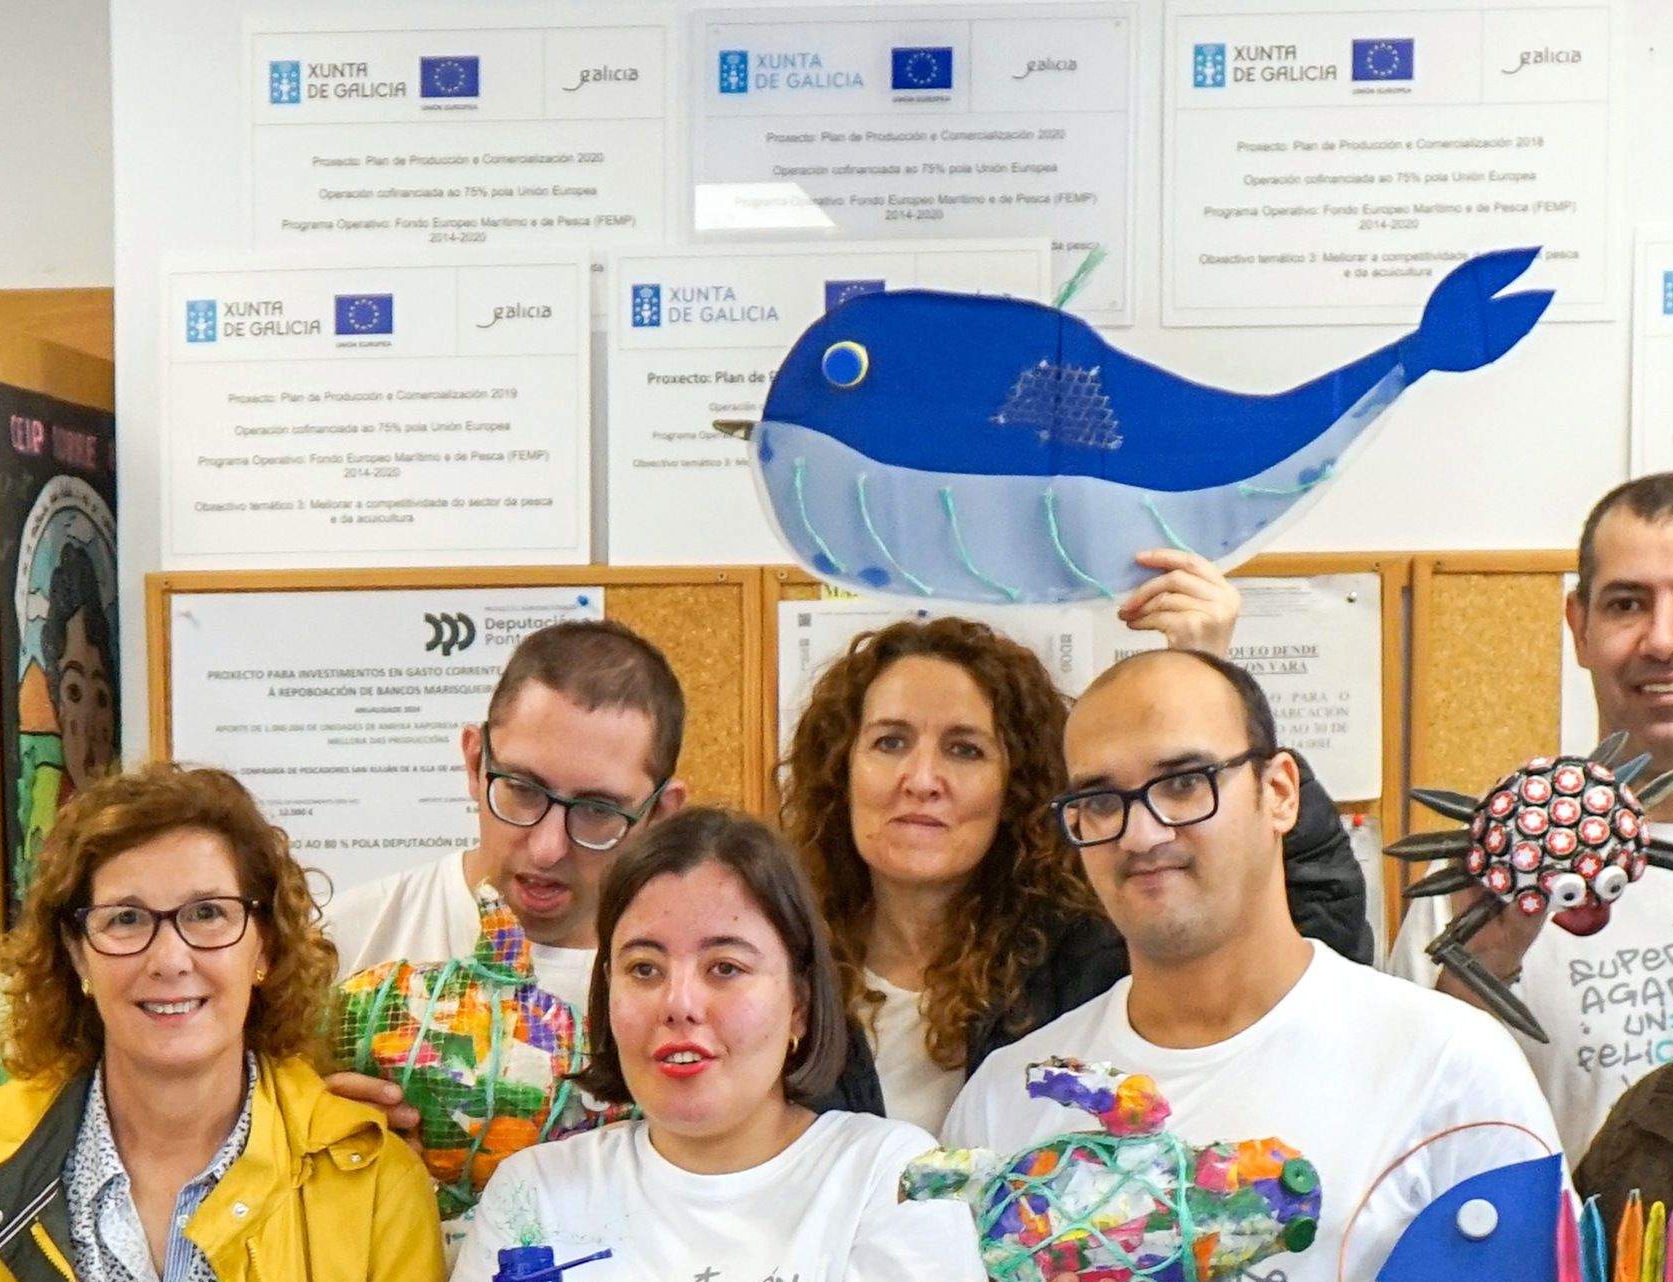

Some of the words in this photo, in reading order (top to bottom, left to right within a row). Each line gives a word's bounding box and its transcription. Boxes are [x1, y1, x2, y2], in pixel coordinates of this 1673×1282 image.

[1234, 45, 1296, 61] XUNTA
[308, 62, 368, 78] XUNTA
[756, 53, 822, 71] XUNTA
[755, 73, 779, 91] DE
[787, 72, 864, 89] GALICIA
[1233, 67, 1255, 82] DE
[1261, 65, 1337, 82] GALICIA
[308, 84, 329, 99] DE
[334, 82, 407, 98] GALICIA
[670, 286, 736, 304] XUNTA
[224, 301, 283, 317] XUNTA
[669, 307, 692, 323] DE
[700, 306, 779, 323] GALICIA
[224, 322, 245, 337] DE
[250, 320, 321, 336] GALICIA
[647, 372, 711, 384] Proxecto:
[713, 371, 745, 383] Plan
[747, 371, 765, 383] de
